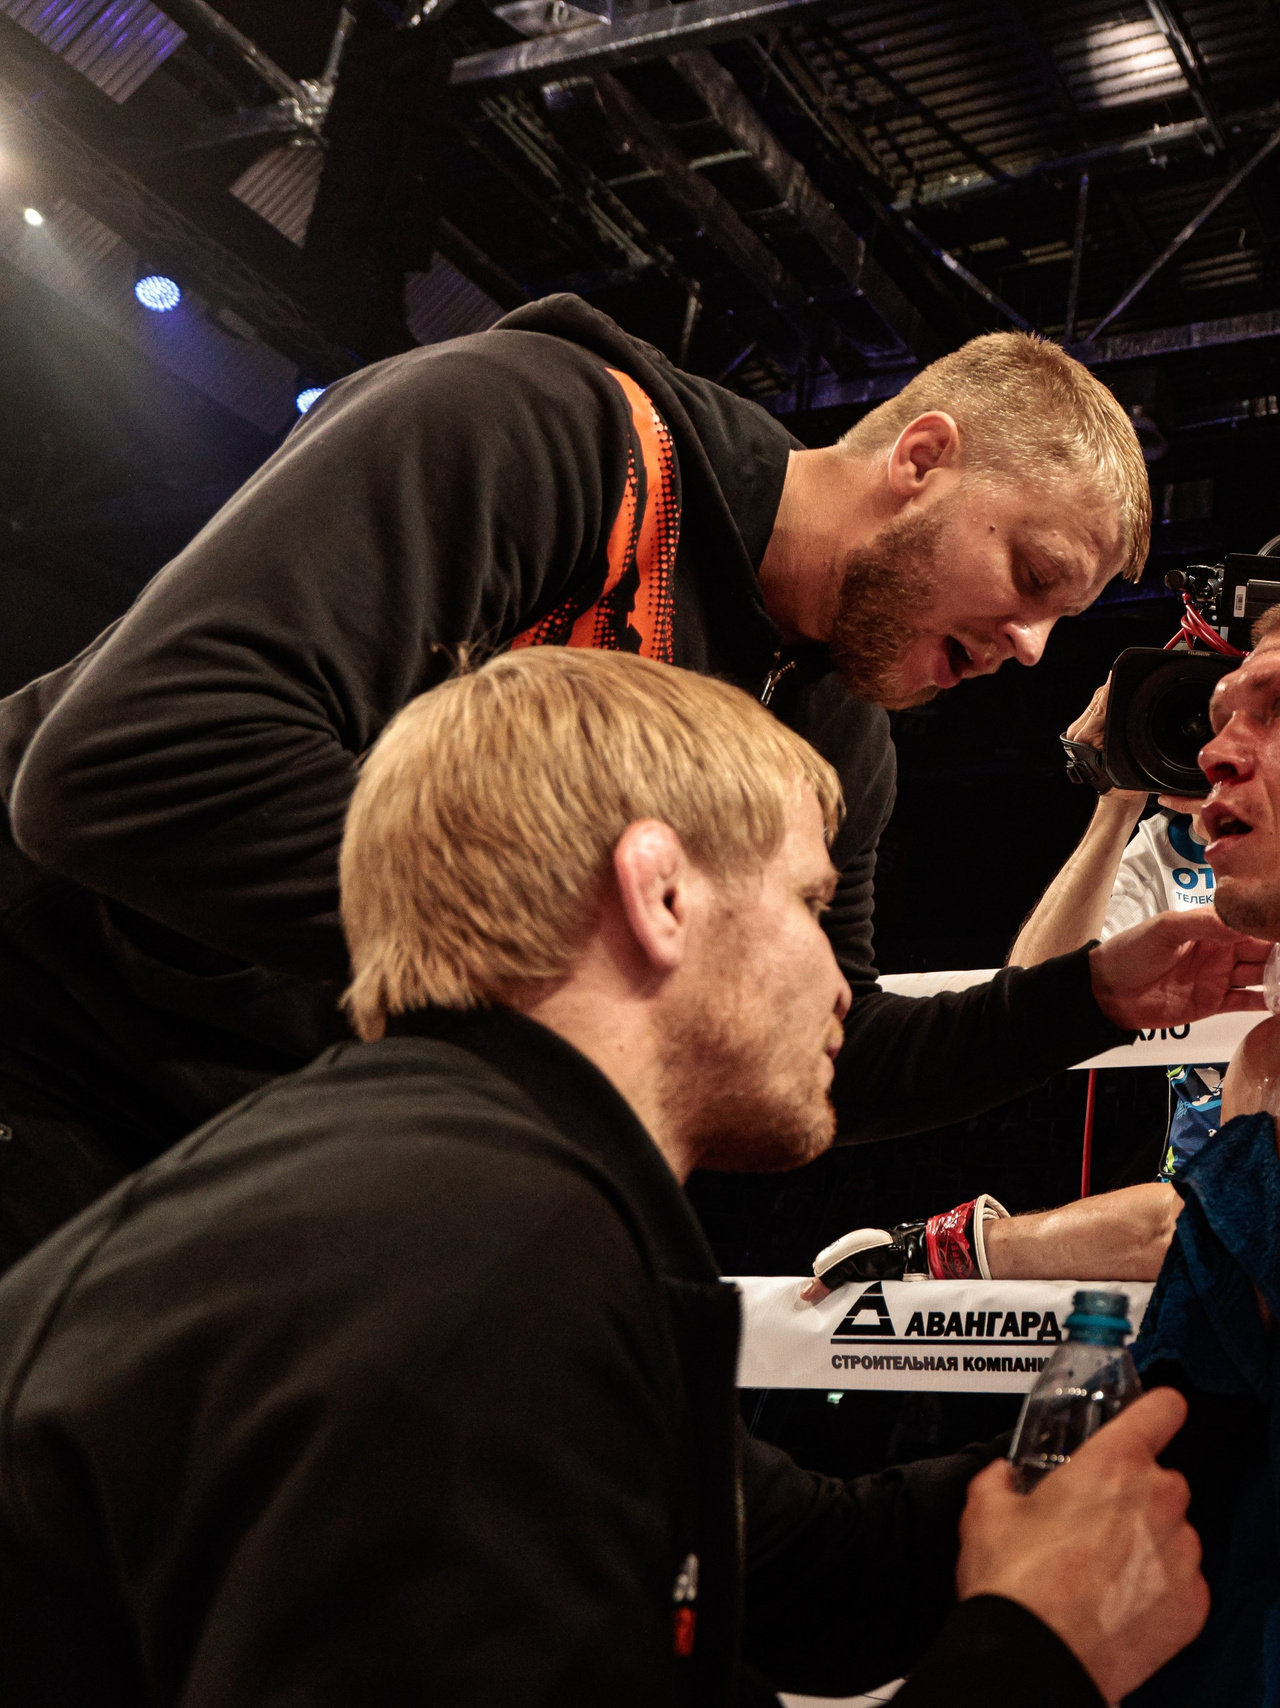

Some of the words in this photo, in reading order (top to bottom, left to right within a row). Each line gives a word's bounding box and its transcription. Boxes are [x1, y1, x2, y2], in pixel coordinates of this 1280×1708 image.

[1172, 867, 1214, 889] ОТ
[1175, 891, 1214, 905] ТЕЛЕК
[904, 1311, 1062, 1343] АВАНГАРД
[831, 1354, 959, 1372] СТРОИТЕЛЬНАЯ
[963, 1356, 1051, 1373] КОМПАНИ
